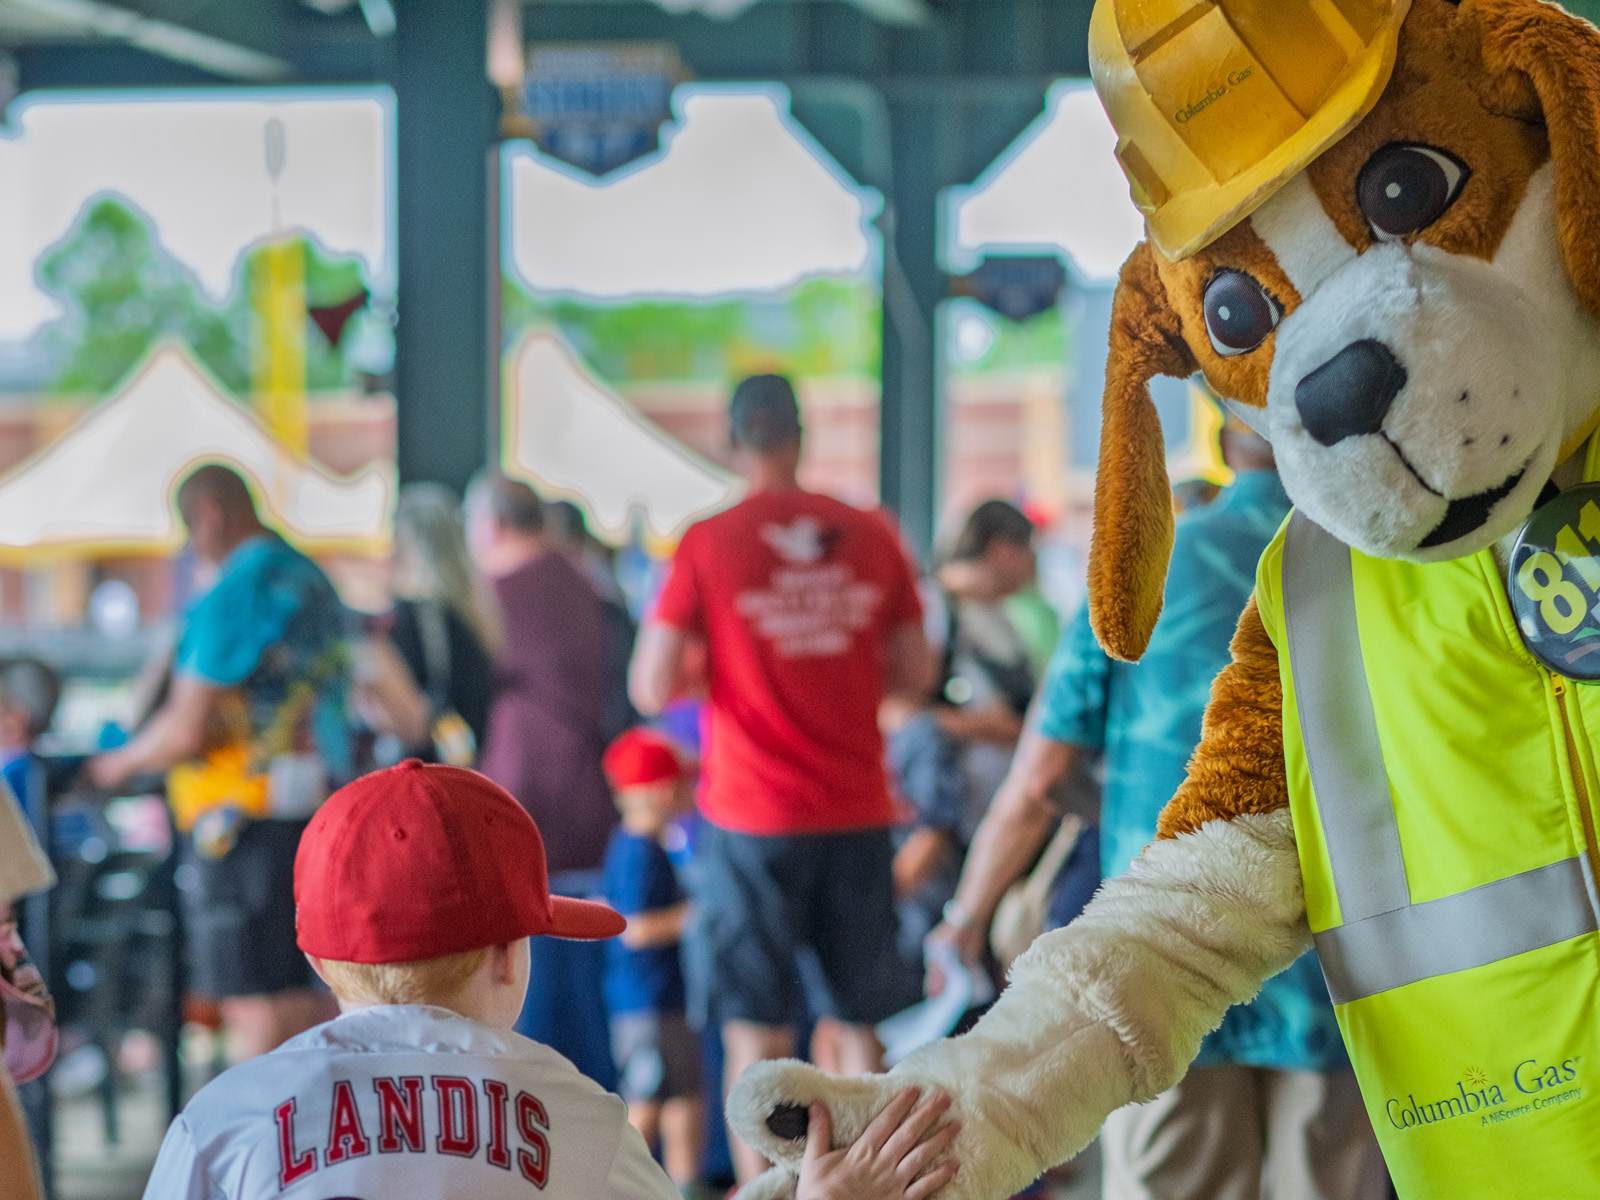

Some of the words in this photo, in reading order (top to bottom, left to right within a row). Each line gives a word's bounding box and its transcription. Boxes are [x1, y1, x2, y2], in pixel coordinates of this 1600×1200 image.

[1175, 86, 1226, 123] Columbia
[1227, 67, 1252, 86] Gas
[1386, 1081, 1505, 1129] Columbia
[1513, 1058, 1576, 1094] Gas
[1532, 1087, 1582, 1111] Company
[275, 1075, 551, 1191] LANDIS
